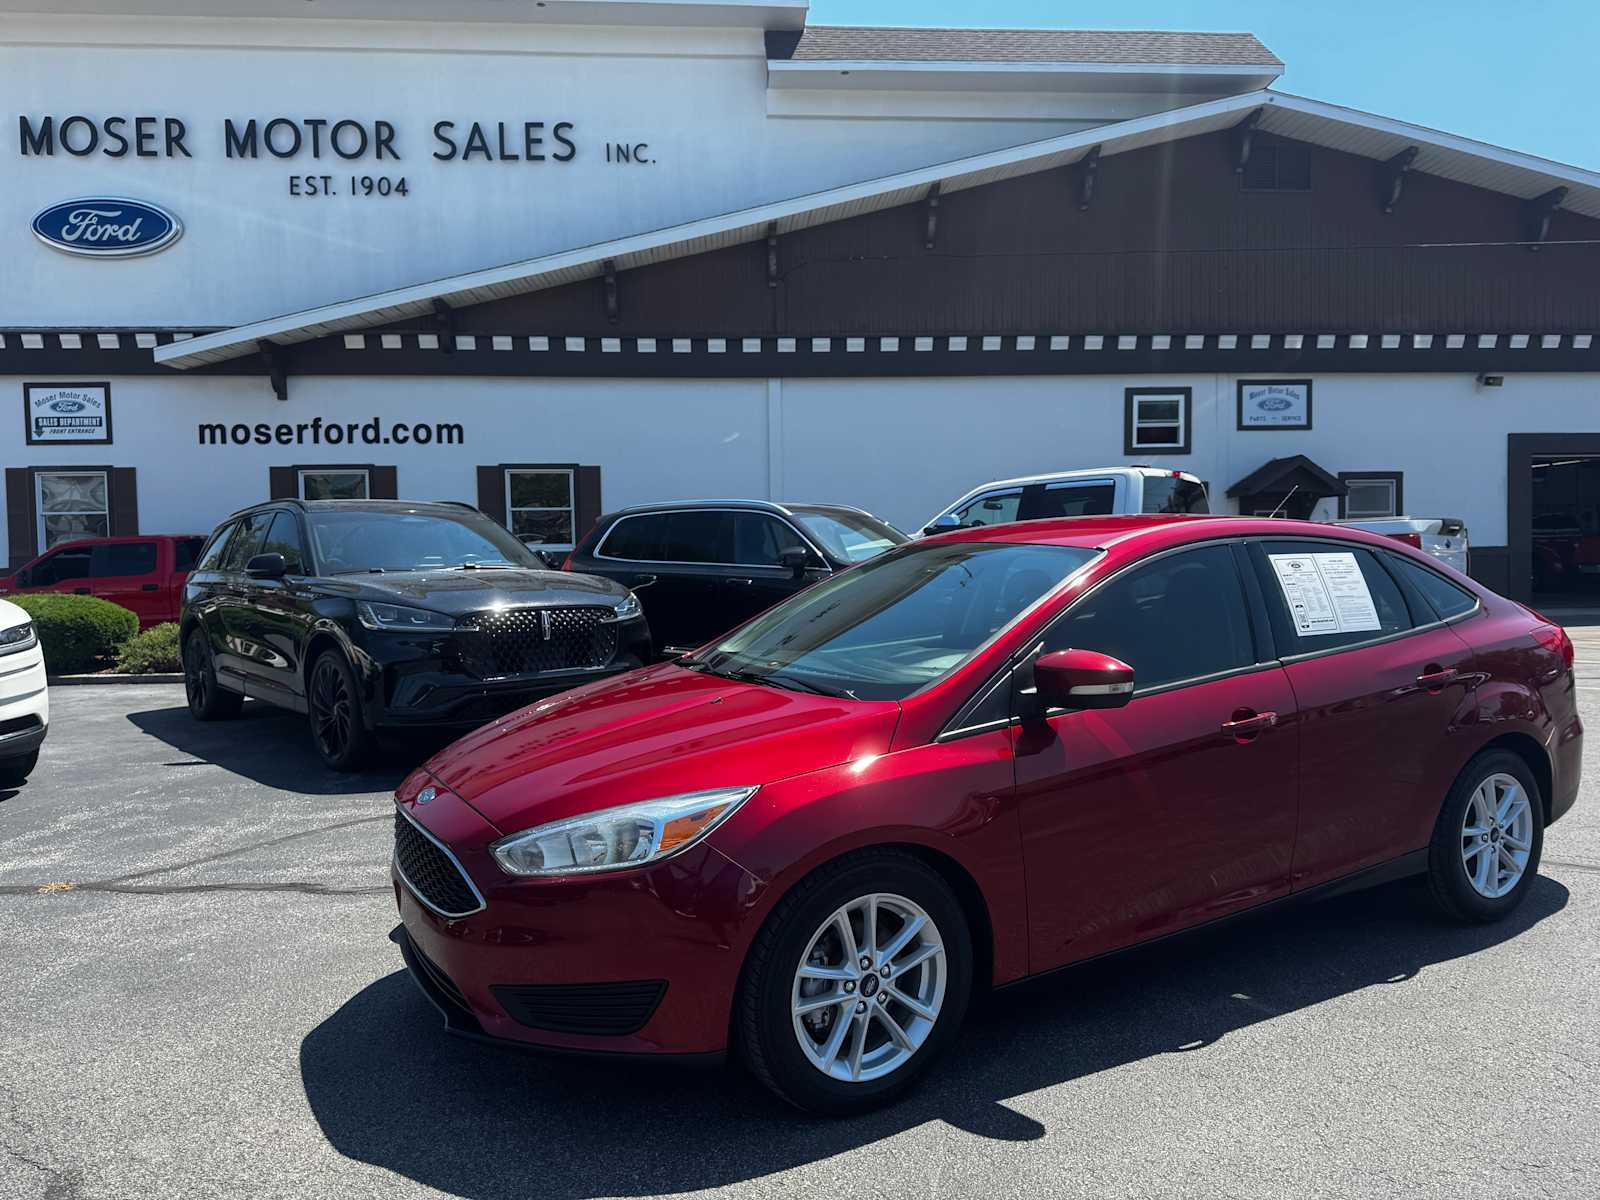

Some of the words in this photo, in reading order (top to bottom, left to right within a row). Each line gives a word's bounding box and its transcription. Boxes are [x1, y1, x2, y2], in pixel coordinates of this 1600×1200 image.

[20, 116, 192, 158] MOSER
[225, 118, 400, 160] MOTOR
[433, 121, 576, 162] SALES
[606, 142, 656, 163] INC.
[290, 176, 336, 197] EST.
[351, 176, 409, 197] 1904
[61, 209, 144, 241] Ford
[35, 394, 57, 408] Moser
[59, 391, 81, 401] Motor
[82, 393, 102, 409] Sales
[38, 418, 58, 427] SALES
[60, 418, 100, 427] DEPARTMENT
[198, 416, 465, 446] moserford.com
